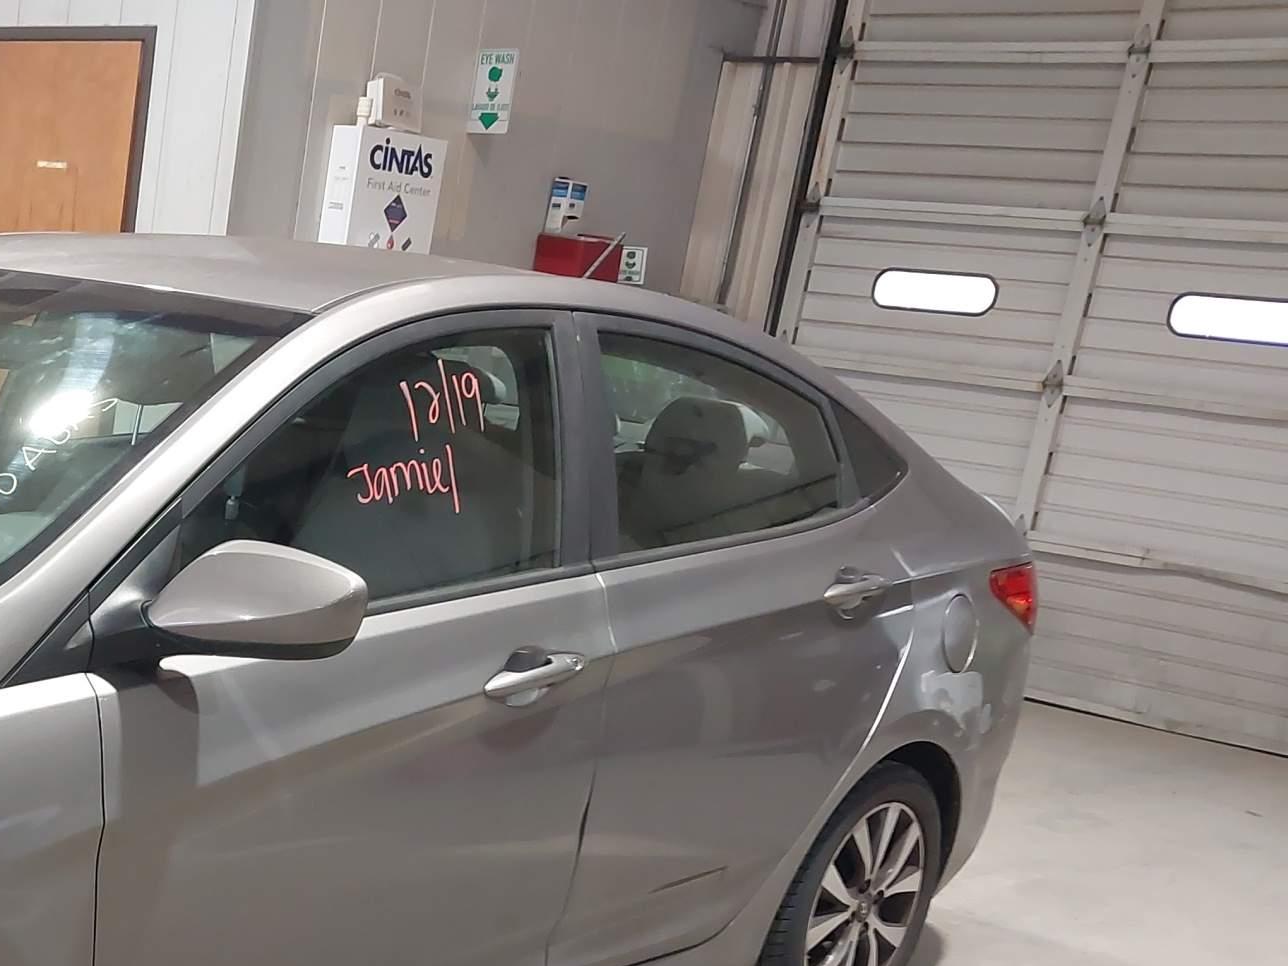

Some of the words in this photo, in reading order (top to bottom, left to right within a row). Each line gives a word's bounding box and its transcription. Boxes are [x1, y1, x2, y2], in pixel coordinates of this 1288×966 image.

[481, 53, 494, 65] EYE
[495, 53, 515, 65] WASH
[367, 177, 386, 191] First
[387, 180, 403, 193] Aid
[404, 183, 432, 197] Center
[399, 358, 485, 442] 12/19
[347, 444, 460, 513] Jamiel
